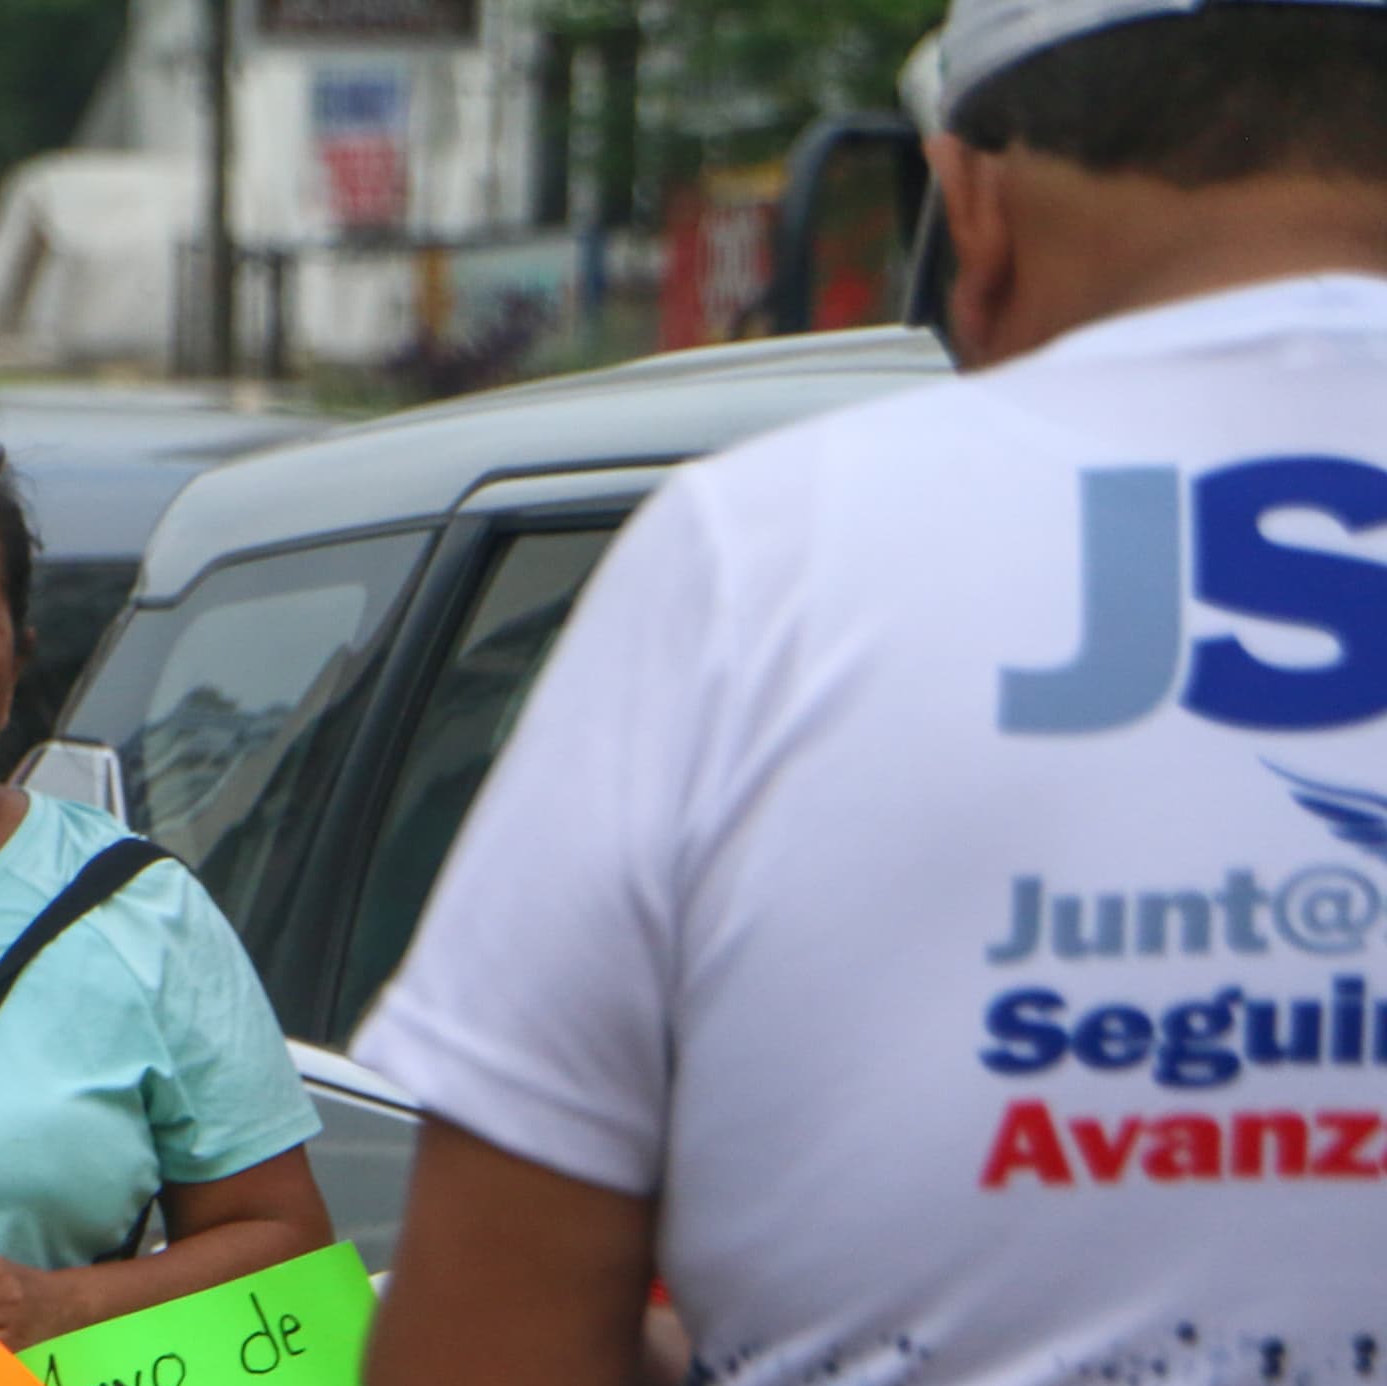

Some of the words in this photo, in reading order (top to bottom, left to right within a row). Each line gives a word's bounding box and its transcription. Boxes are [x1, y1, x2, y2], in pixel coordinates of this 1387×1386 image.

[984, 864, 1387, 967] Junt@
[978, 1098, 1387, 1193] Avanz
[239, 1291, 306, 1375] de
